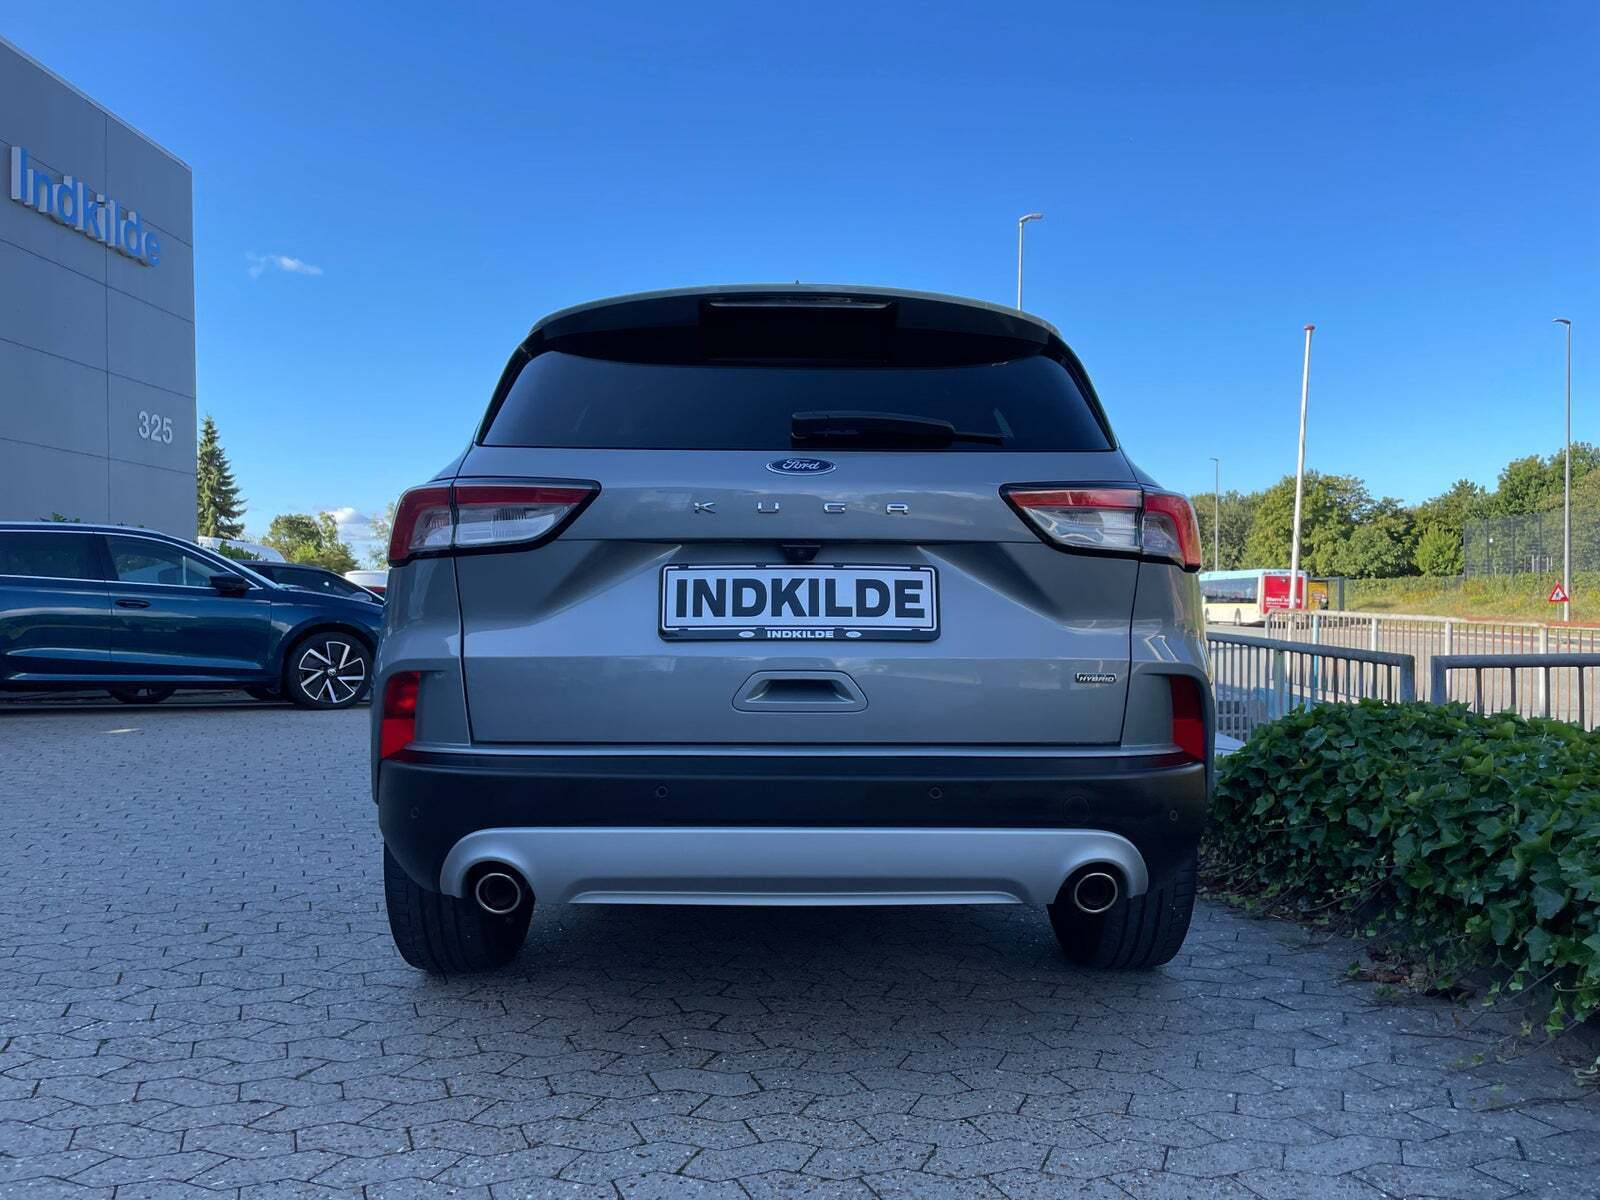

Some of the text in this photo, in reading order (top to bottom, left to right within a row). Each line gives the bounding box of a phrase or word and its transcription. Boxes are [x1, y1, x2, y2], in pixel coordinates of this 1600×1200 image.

[10, 146, 161, 268] Indkilde
[138, 410, 173, 444] 325
[782, 459, 820, 470] Ford
[693, 501, 911, 515] KUGA
[675, 577, 926, 619] INDKILDE
[766, 630, 835, 639] INDKILDE
